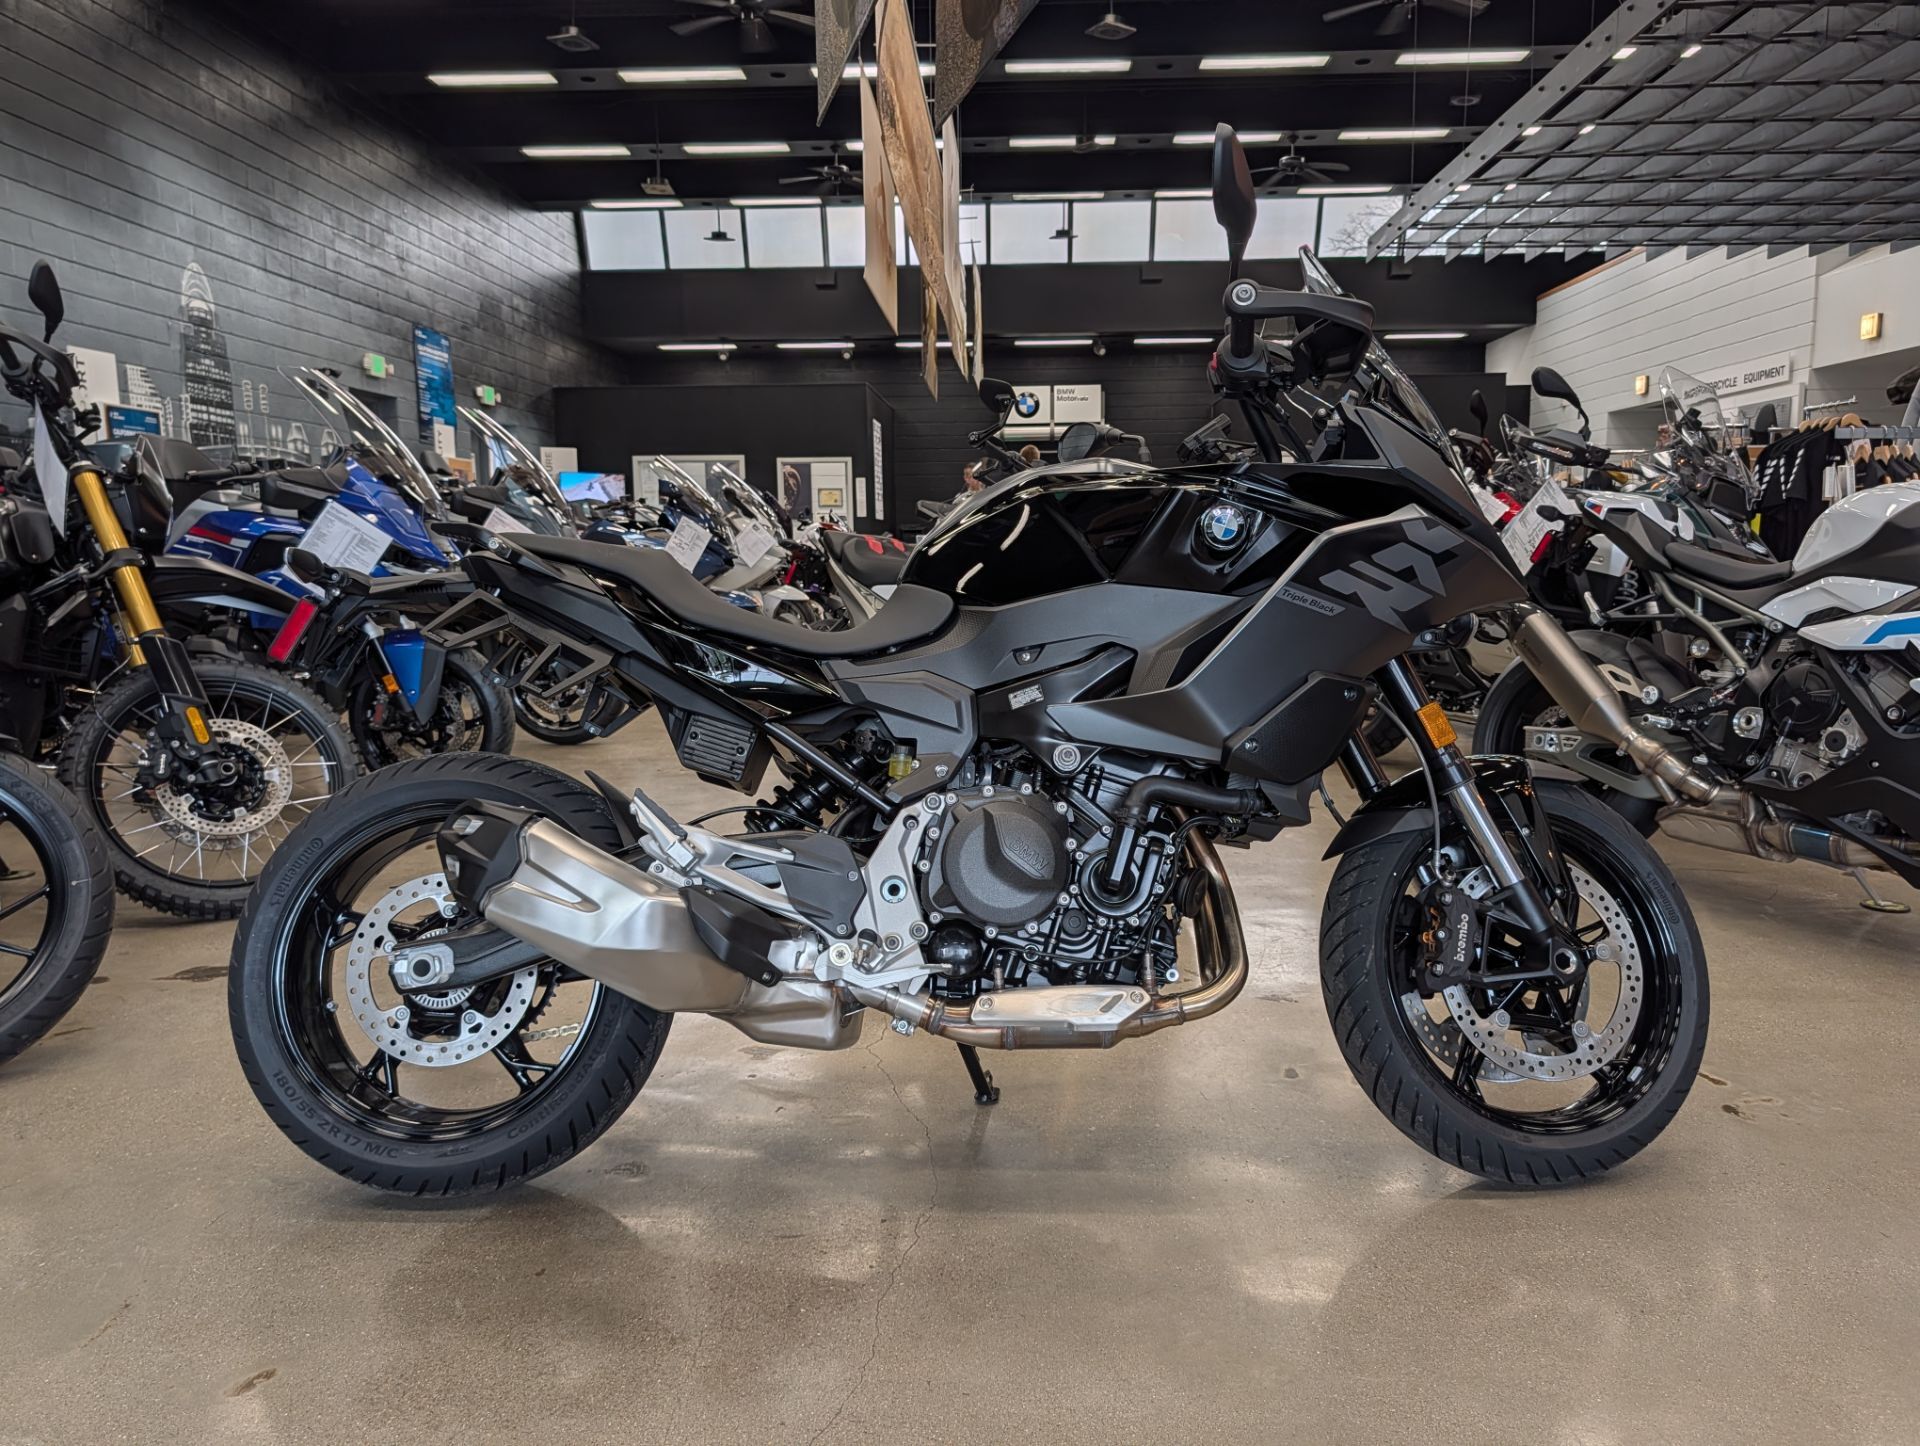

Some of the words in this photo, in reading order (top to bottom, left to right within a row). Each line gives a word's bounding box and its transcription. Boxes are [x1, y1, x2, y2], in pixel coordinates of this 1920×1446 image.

[1743, 365, 1786, 384] EQUIPMENT
[1282, 588, 1309, 605] Triple
[1309, 597, 1337, 614] Black
[272, 837, 323, 900] Continental
[1010, 838, 1049, 870] BMW
[1453, 913, 1469, 961] brembo
[273, 1071, 317, 1120] 180/55
[317, 1119, 341, 1138] ZR
[343, 1134, 362, 1147] 17
[364, 1140, 399, 1159] M/C
